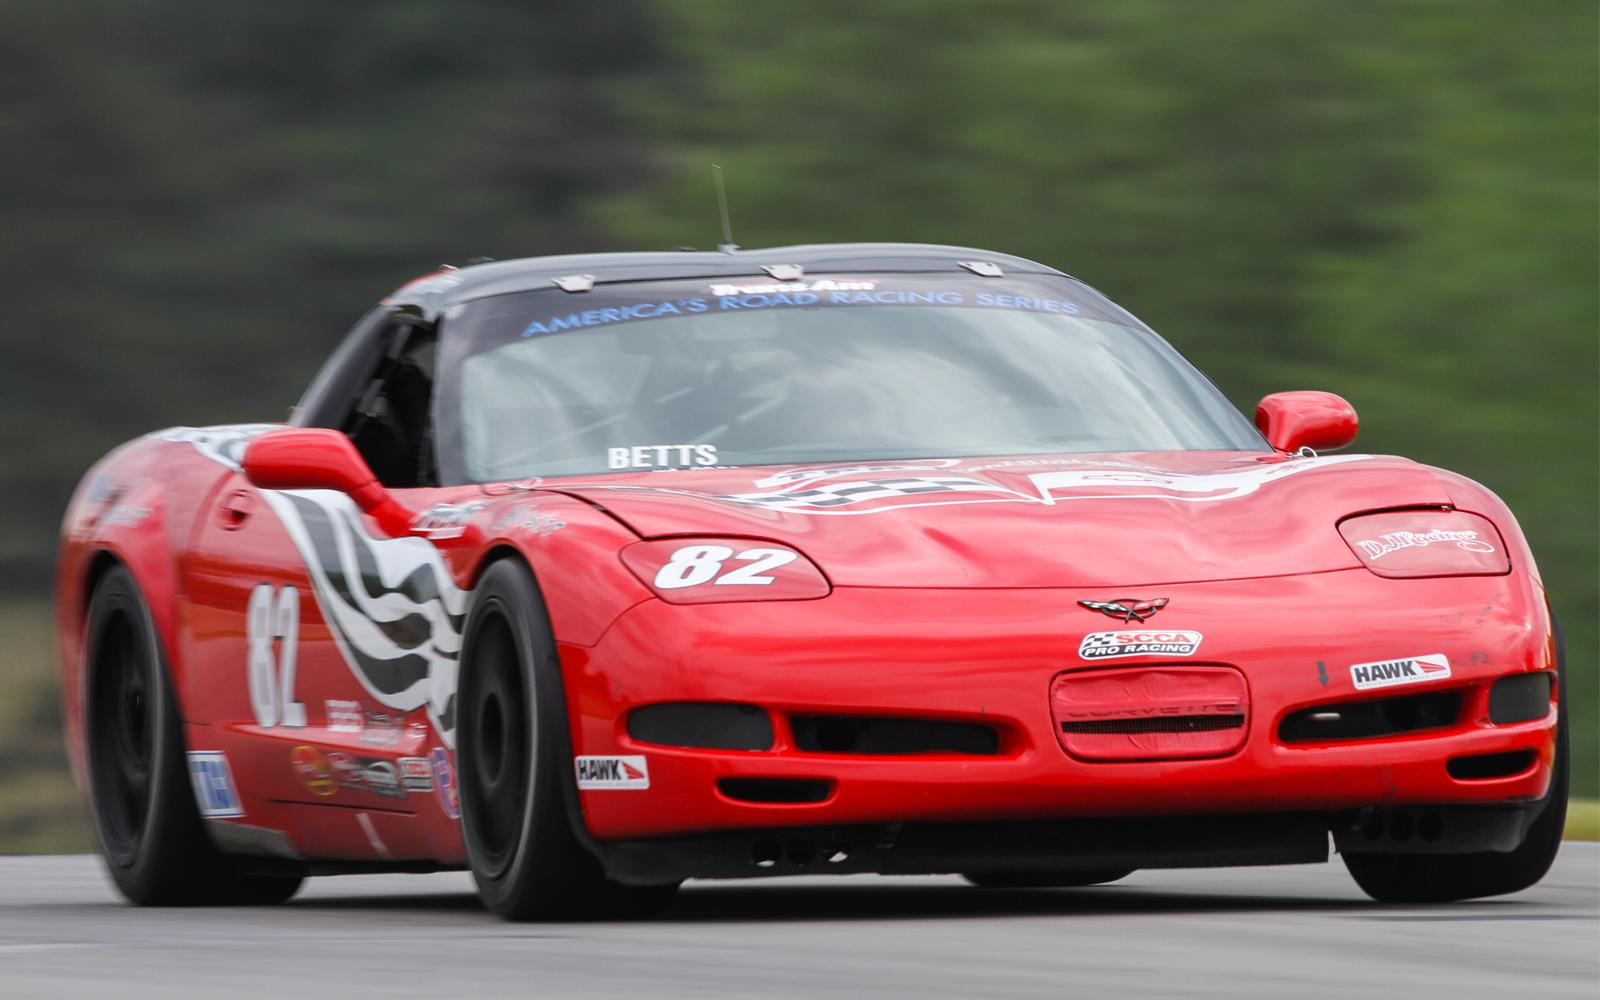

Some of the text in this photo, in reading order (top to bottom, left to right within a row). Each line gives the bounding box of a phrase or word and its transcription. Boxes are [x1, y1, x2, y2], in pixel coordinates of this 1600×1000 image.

[521, 290, 1080, 337] AMERICA'S ROAD RACING SERIES
[608, 444, 719, 469] BETTS
[653, 545, 798, 589] 82
[1084, 644, 1192, 656] PRO RACING
[1115, 633, 1192, 645] SCCA
[247, 582, 308, 728] 82
[1354, 660, 1417, 683] HAWK
[577, 759, 622, 780] HAWK
